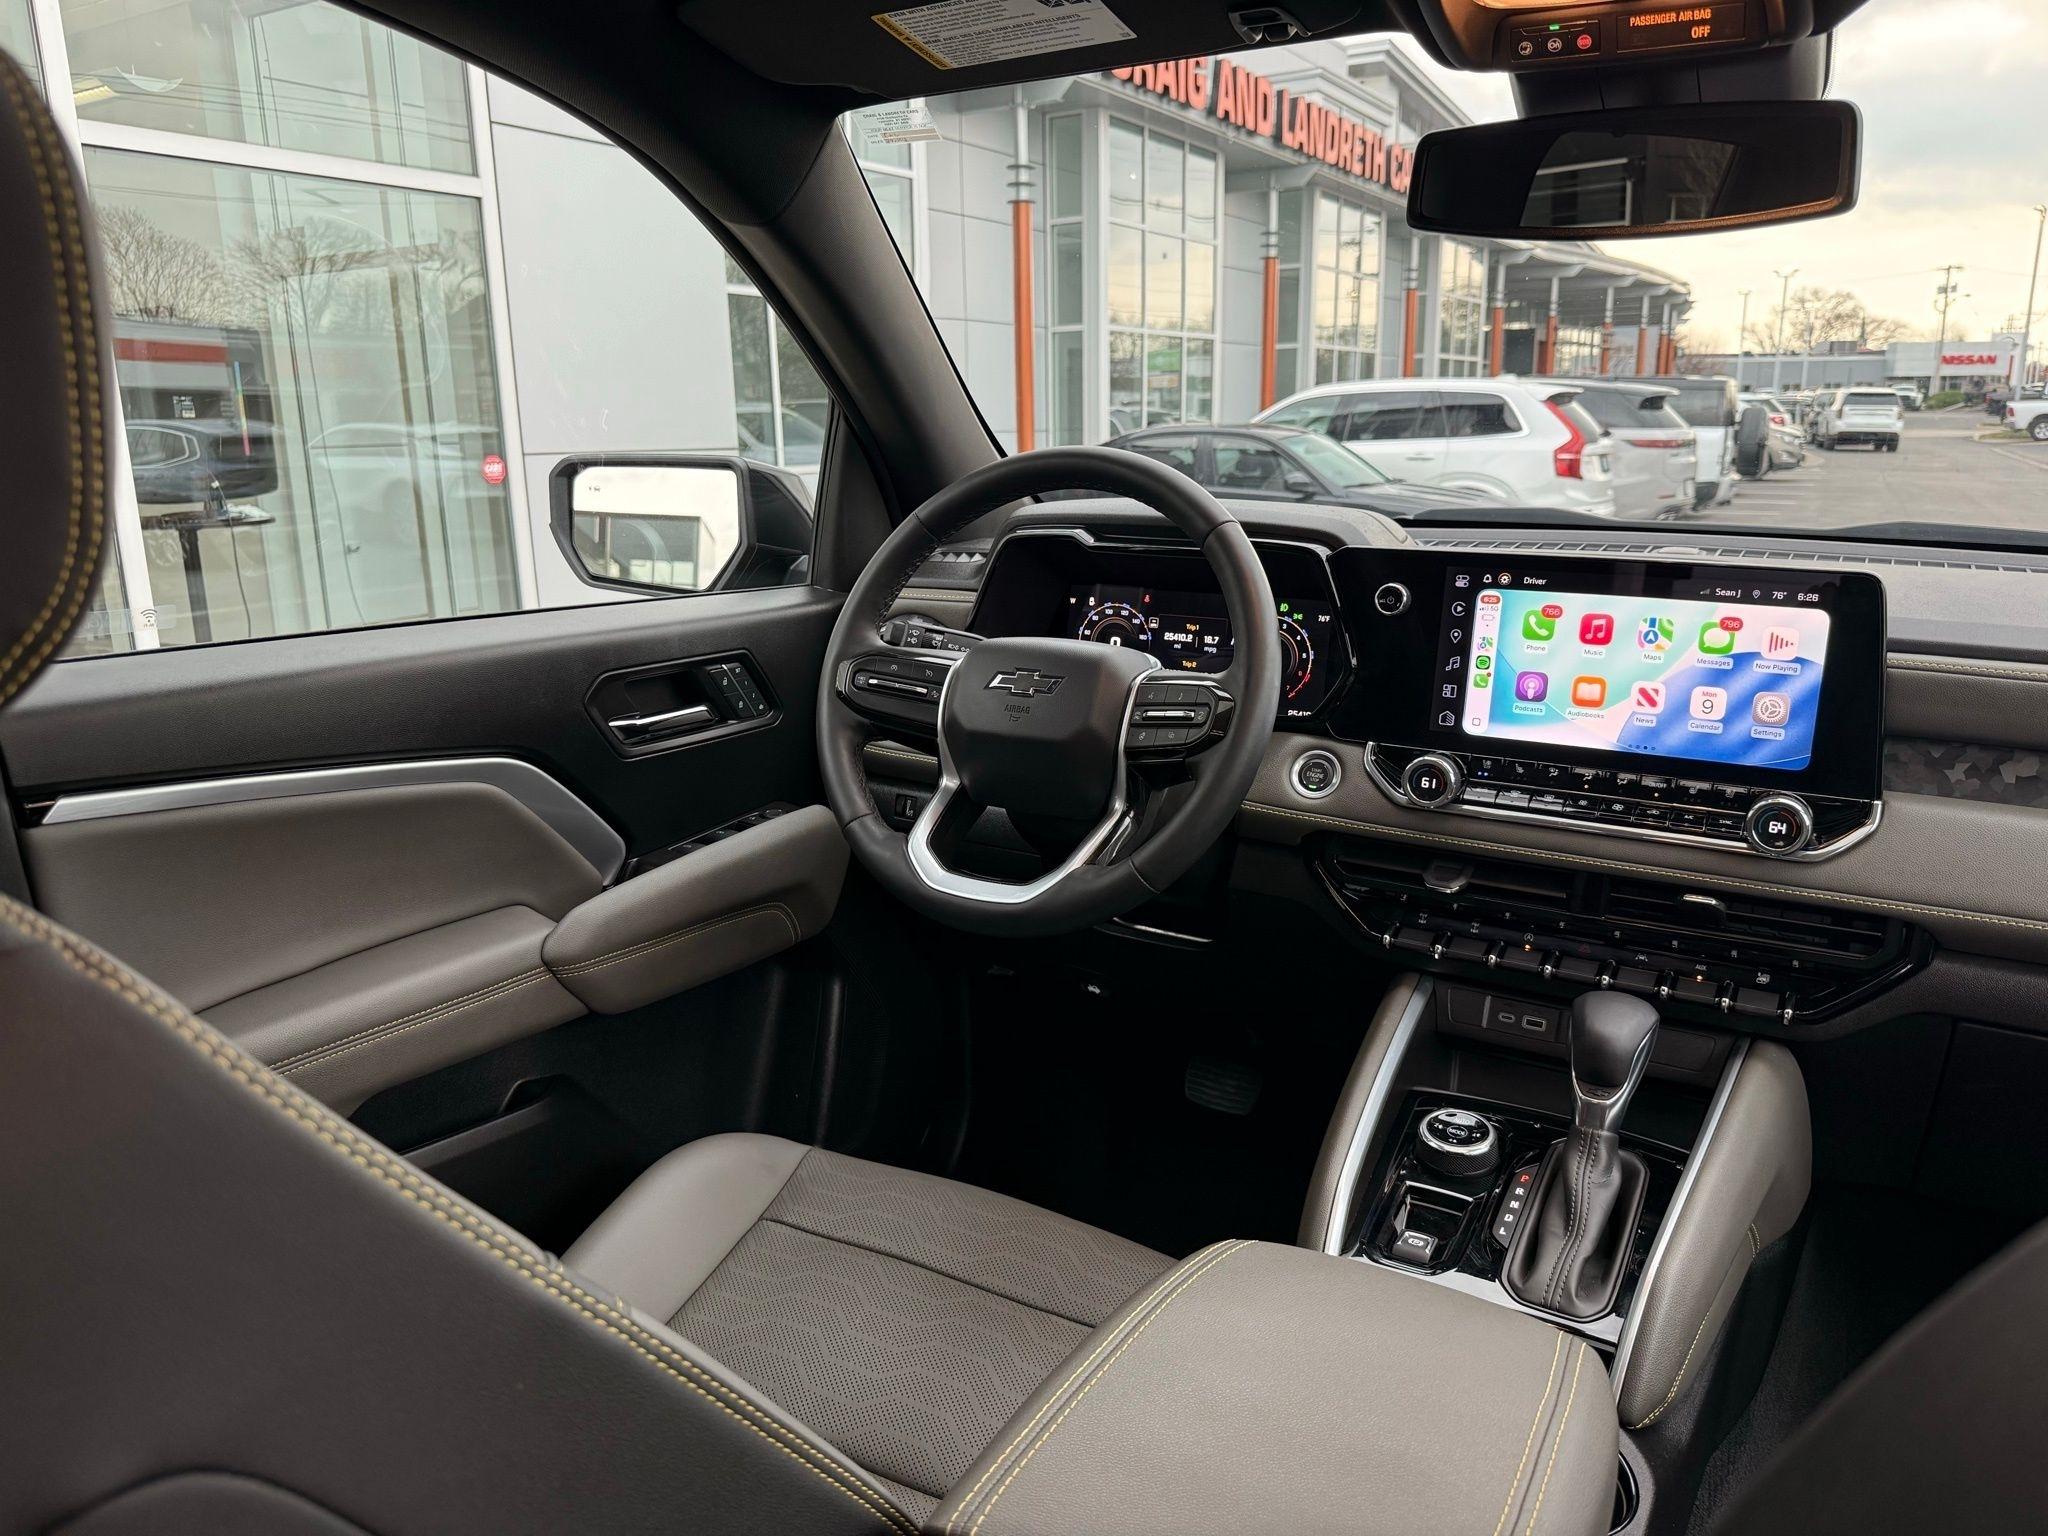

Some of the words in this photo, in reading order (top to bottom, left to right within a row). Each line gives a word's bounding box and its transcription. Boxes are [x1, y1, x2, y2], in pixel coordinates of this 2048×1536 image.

[1630, 14, 1677, 27] PASSENGER
[1679, 12, 1694, 22] AIR
[1694, 9, 1712, 21] BAG
[1691, 26, 1711, 39] OFF
[1109, 55, 1208, 111] RAIG
[1215, 58, 1275, 138] AND
[1280, 87, 1387, 185] LANDRETH
[1941, 354, 1998, 365] NISSAN
[1523, 576, 1547, 586] Driver
[1715, 587, 1736, 597] Sean
[1772, 590, 1788, 600] 76°
[1797, 592, 1820, 602] 6:26
[1544, 607, 1561, 616] 766
[1722, 619, 1741, 629] 796
[1163, 631, 1193, 642] 25410.2
[1203, 646, 1217, 654] mpg
[1526, 644, 1546, 652] Phone
[1583, 648, 1604, 657] Music
[1643, 653, 1662, 662] Maps
[1696, 657, 1731, 668] Messages
[1755, 662, 1771, 671] Now
[1772, 664, 1799, 674] Playing
[1701, 690, 1718, 699] Mon
[1004, 703, 1031, 715] AIRBAG
[1514, 705, 1543, 714] Podcasts
[1701, 698, 1714, 715] 9
[1567, 709, 1605, 720] Audiobooks
[1635, 716, 1654, 725] News
[1690, 721, 1721, 732] Calendar
[1753, 728, 1783, 739] Settings
[1306, 770, 1325, 780] ENGINE
[1420, 776, 1437, 789] 61
[1768, 820, 1787, 835] 64
[1520, 1174, 1530, 1183] P
[1514, 1187, 1525, 1196] R
[1509, 1200, 1520, 1209] N
[1504, 1213, 1514, 1222] D
[1499, 1226, 1506, 1235] L
